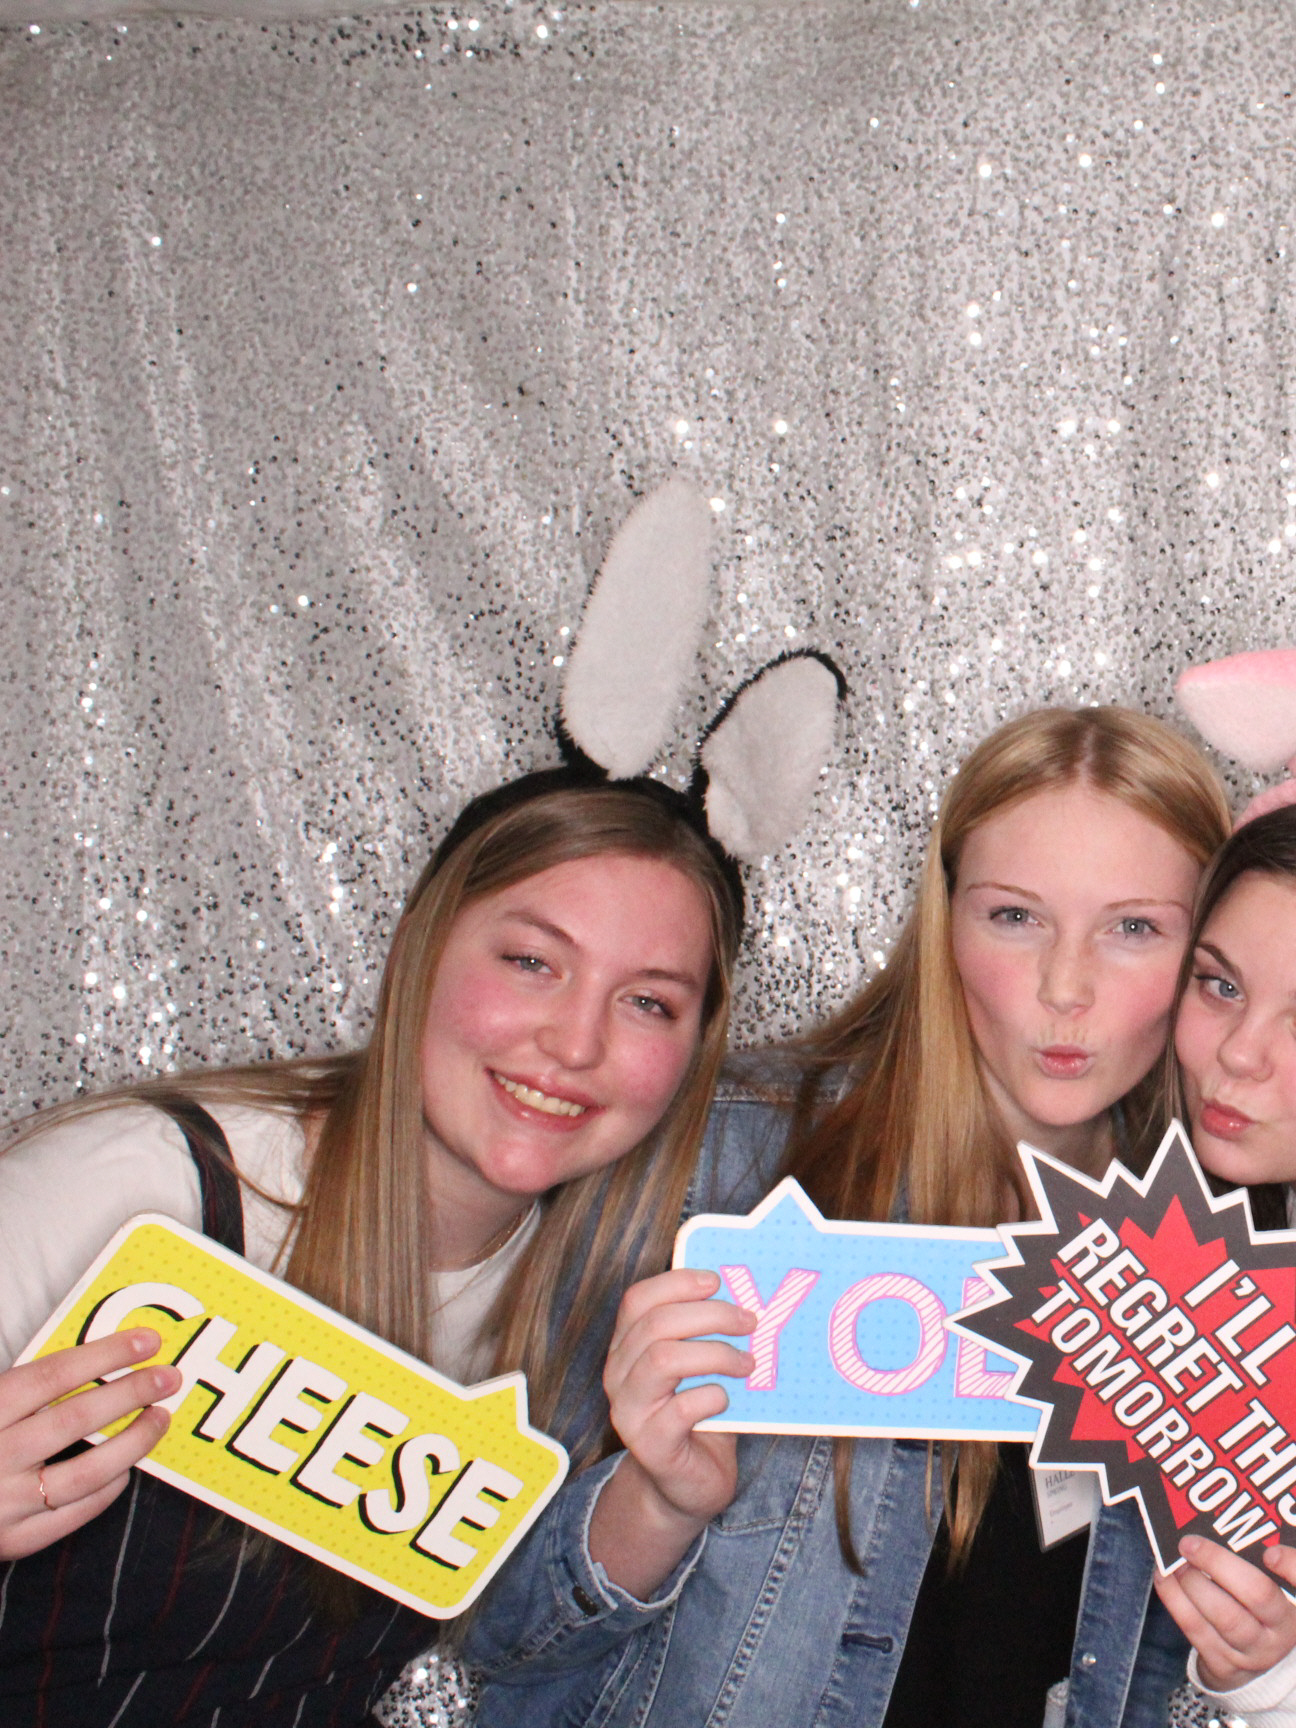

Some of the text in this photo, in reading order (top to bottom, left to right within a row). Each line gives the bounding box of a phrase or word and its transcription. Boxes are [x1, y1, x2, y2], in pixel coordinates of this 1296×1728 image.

[719, 1264, 1016, 1398] YOL
[1056, 1217, 1245, 1413] REGRET
[1031, 1279, 1278, 1553] TOMORROW
